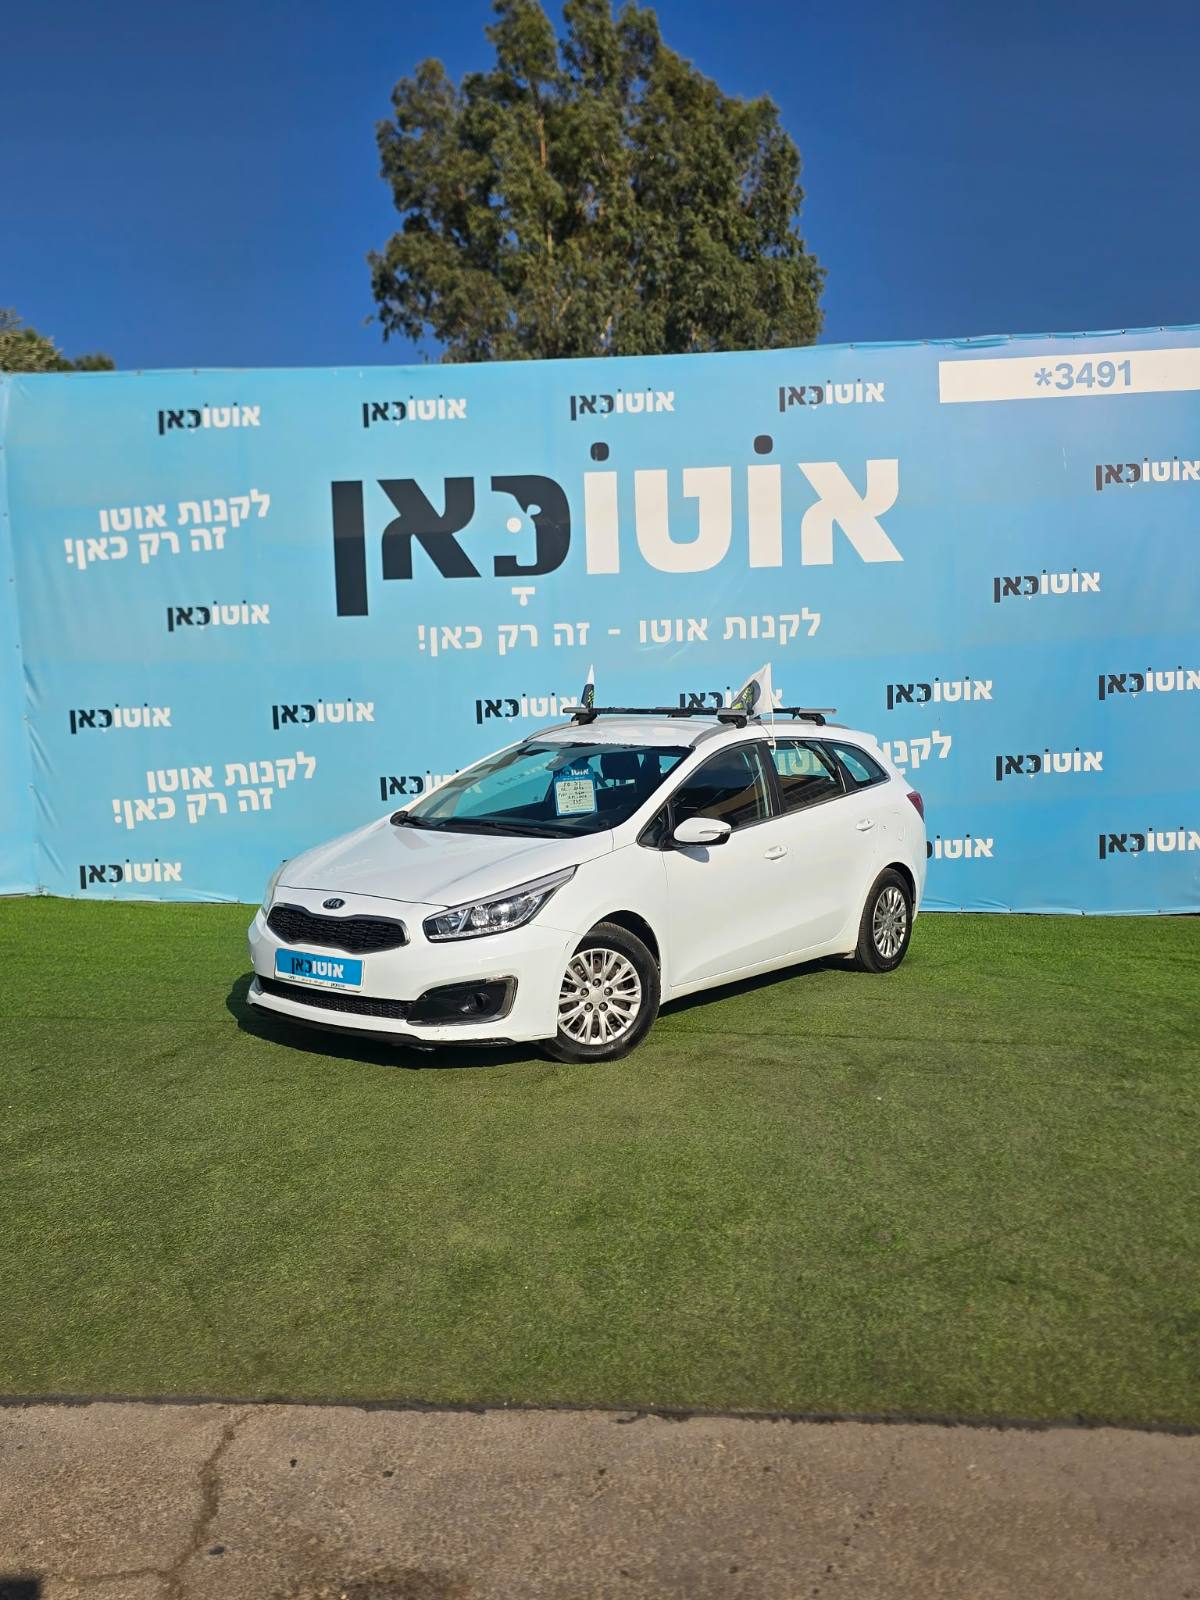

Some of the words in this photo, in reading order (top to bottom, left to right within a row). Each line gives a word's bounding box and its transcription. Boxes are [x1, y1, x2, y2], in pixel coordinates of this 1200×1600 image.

[99, 504, 166, 532] אוטו
[177, 489, 270, 528] לקנות
[64, 534, 128, 570] כאן!
[138, 530, 180, 564] רק
[191, 526, 226, 551] זה
[418, 624, 482, 657] כאן!
[498, 624, 538, 655] רק
[553, 622, 590, 646] זה
[639, 618, 708, 643] אוטו
[723, 607, 821, 645] לקנות
[882, 730, 952, 768] לקנו
[146, 766, 214, 793] אוטו
[225, 751, 316, 788] לקנות
[112, 795, 176, 830] כאן!
[186, 792, 227, 823] רק
[237, 787, 273, 812] זה
